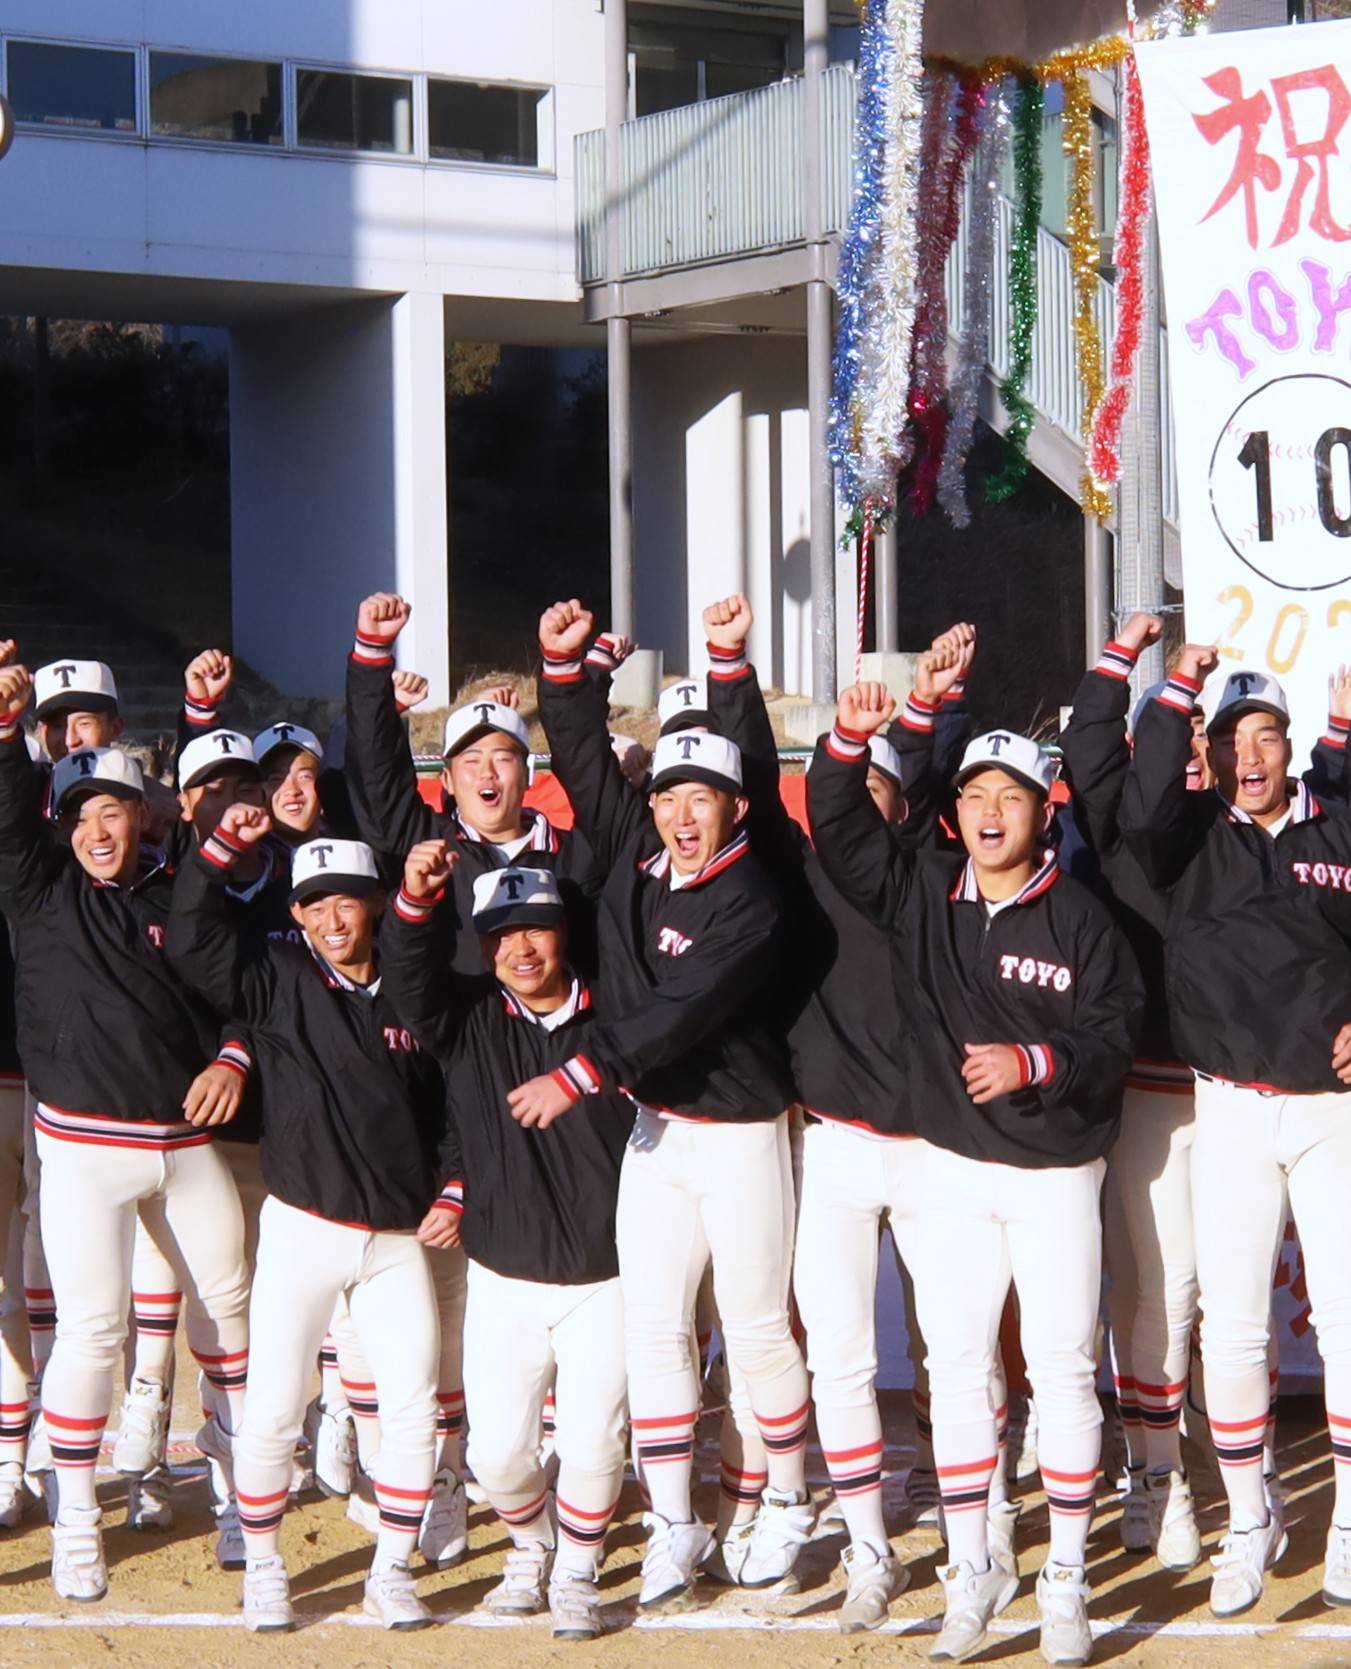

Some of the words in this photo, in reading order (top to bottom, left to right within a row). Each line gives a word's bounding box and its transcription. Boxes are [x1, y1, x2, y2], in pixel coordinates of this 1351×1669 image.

[53, 665, 77, 688] T
[1231, 672, 1255, 696] T
[676, 684, 697, 706] T
[473, 703, 496, 724] T
[212, 733, 236, 754] T
[273, 725, 295, 741] T
[676, 736, 701, 759] T
[987, 734, 1011, 756] T
[72, 751, 96, 775] T
[310, 845, 333, 868] T
[500, 874, 524, 900] T
[1000, 954, 1072, 993] TOYO
